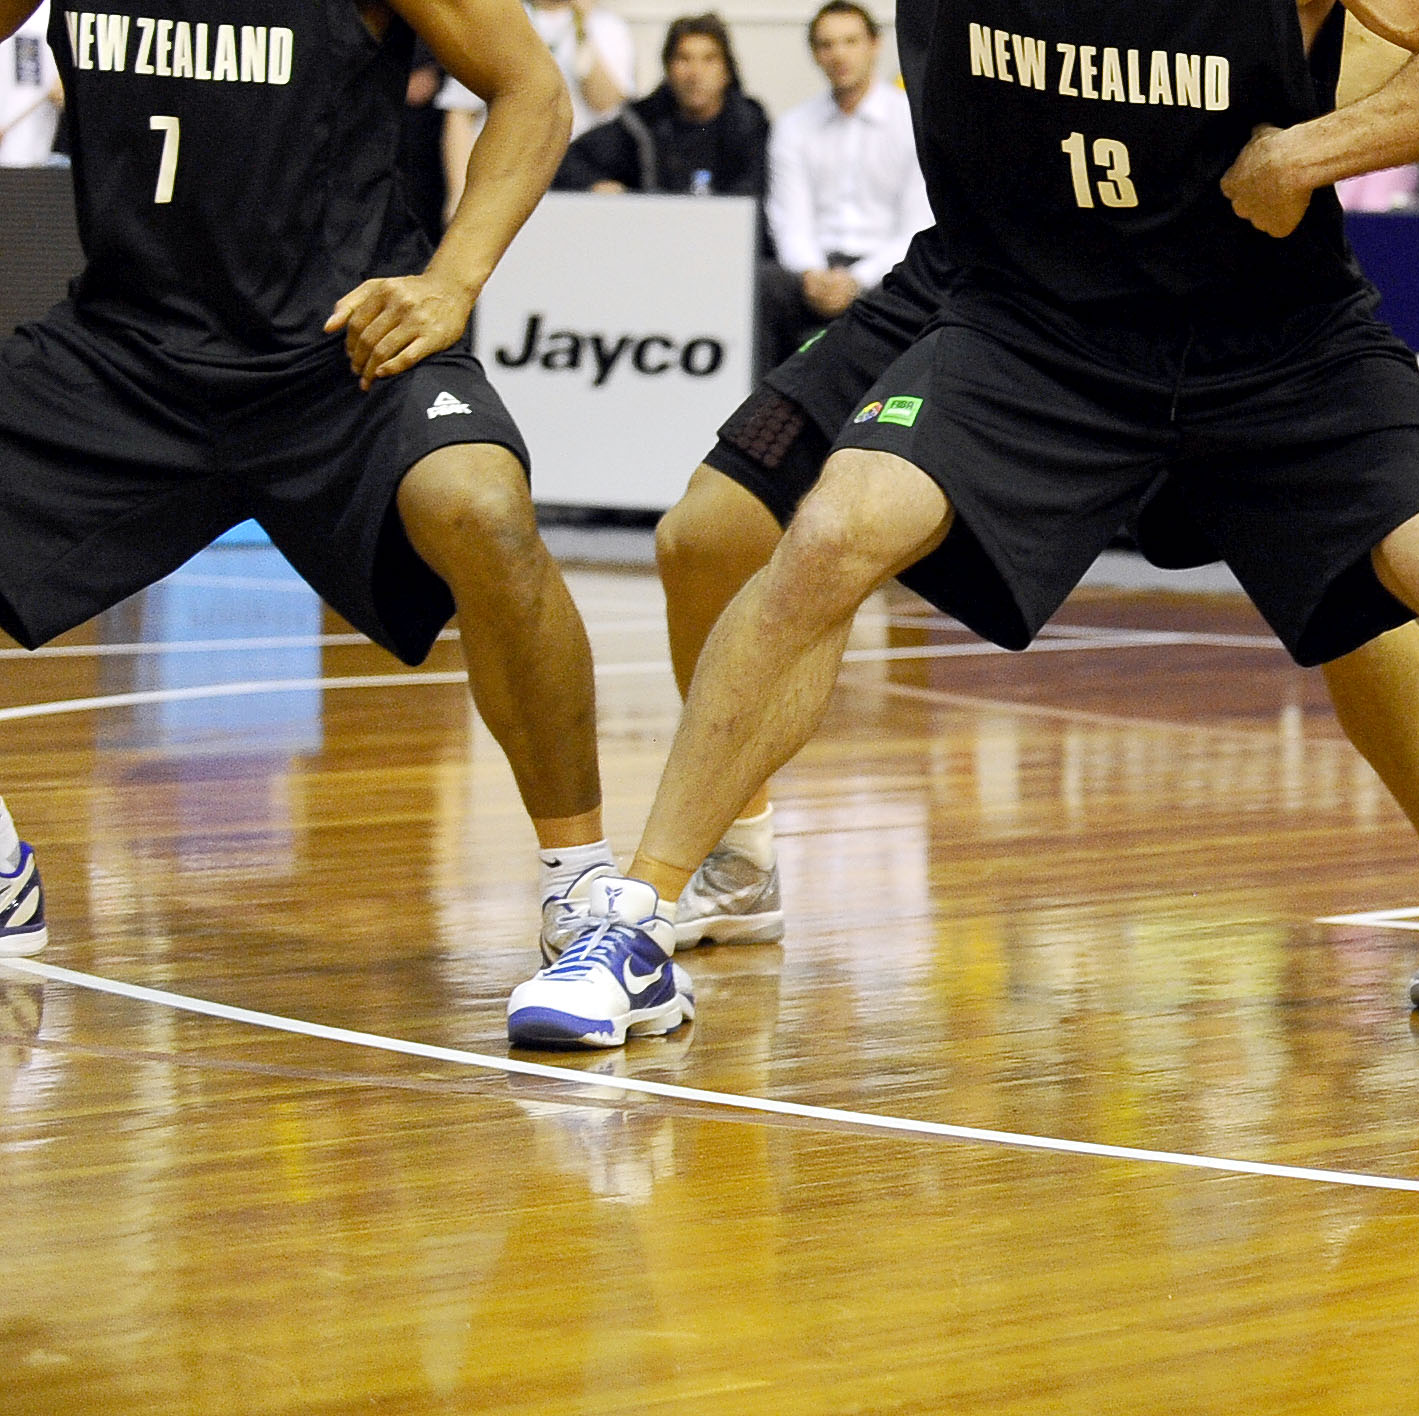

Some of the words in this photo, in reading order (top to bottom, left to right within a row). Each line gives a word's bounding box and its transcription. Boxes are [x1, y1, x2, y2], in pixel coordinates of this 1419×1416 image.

[135, 17, 294, 85] ZEALAND
[968, 22, 1046, 91] NEW
[1056, 42, 1230, 111] ZEALAND
[150, 115, 180, 203] 7
[1061, 132, 1139, 208] 13
[494, 313, 725, 387] Jayco
